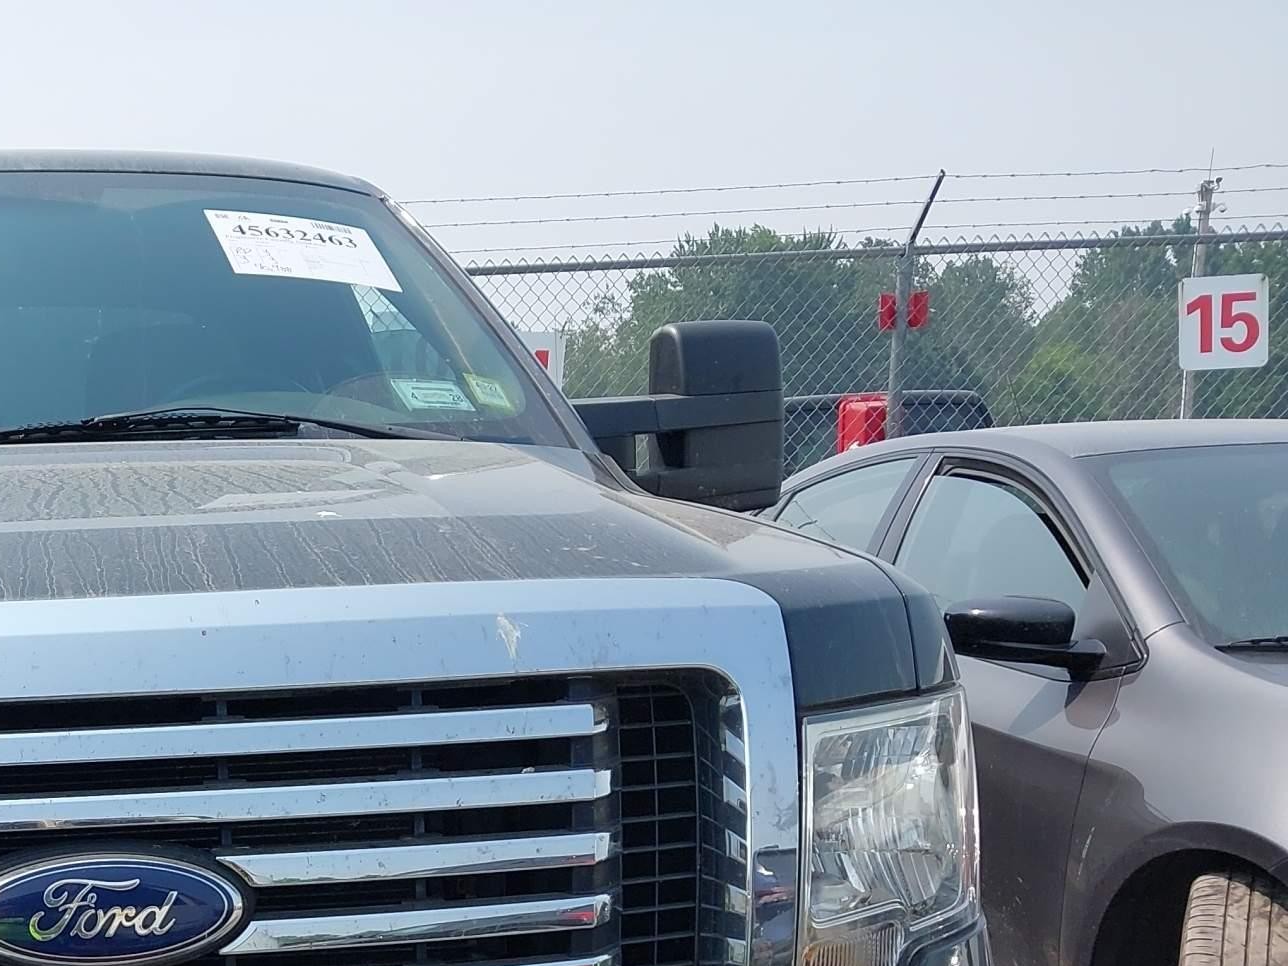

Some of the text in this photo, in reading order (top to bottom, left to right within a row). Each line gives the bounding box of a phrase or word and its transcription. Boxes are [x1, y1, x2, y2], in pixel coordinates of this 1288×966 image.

[232, 224, 358, 249] 45632463
[1186, 291, 1260, 354] 15
[28, 878, 179, 941] Ford
